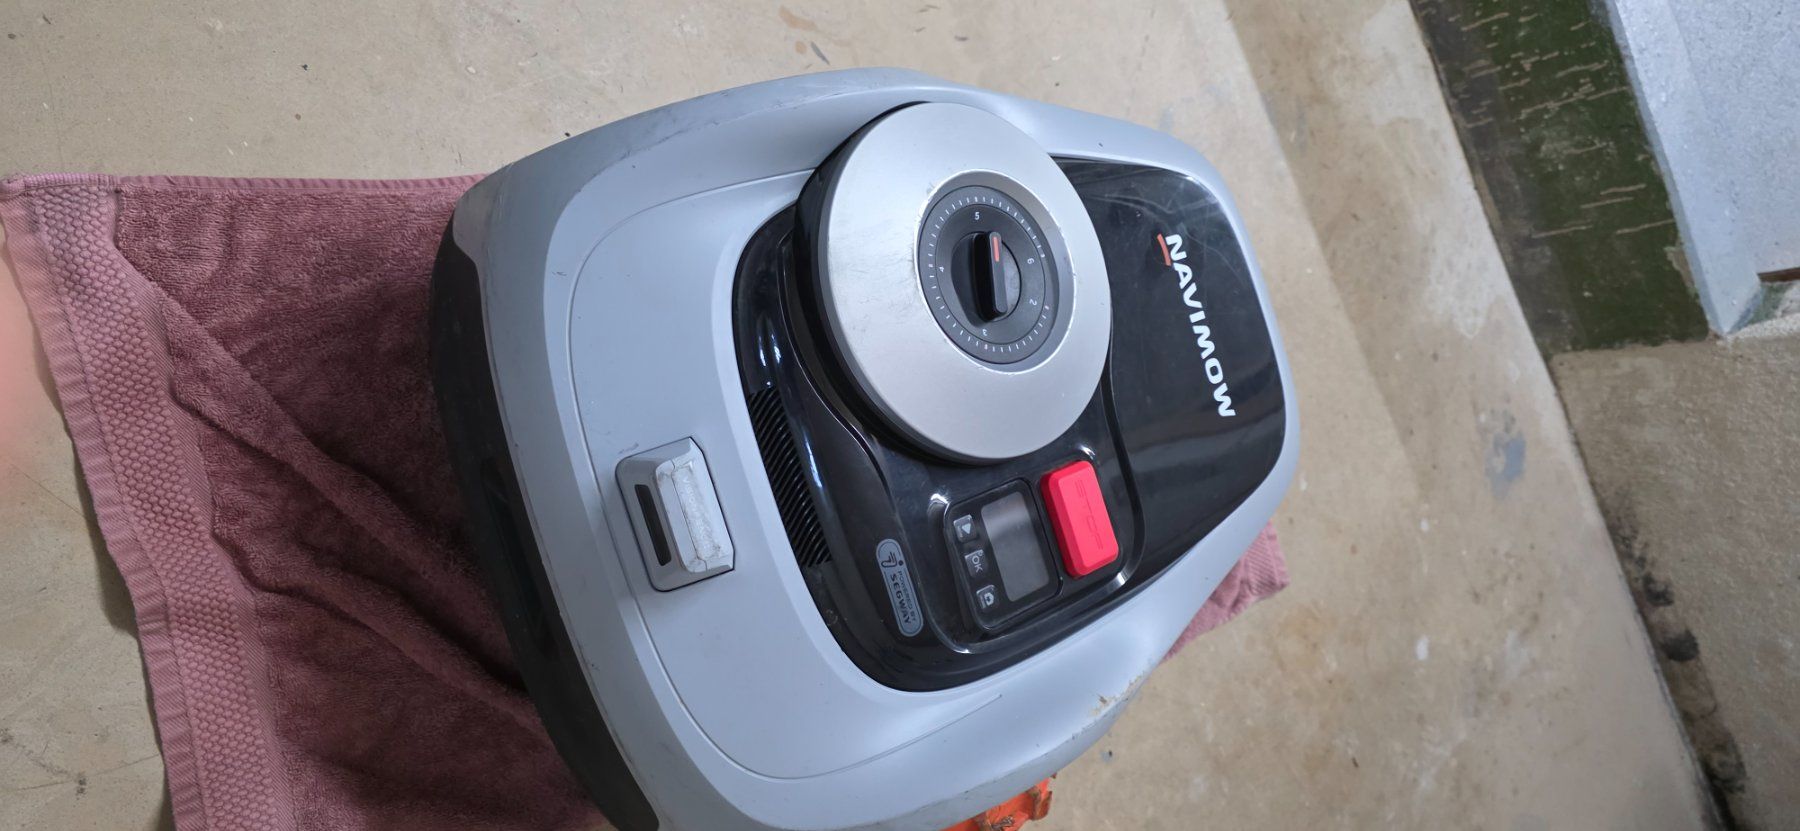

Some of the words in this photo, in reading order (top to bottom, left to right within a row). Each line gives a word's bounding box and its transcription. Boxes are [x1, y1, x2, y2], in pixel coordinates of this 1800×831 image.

[975, 211, 980, 220] 5
[1029, 298, 1037, 306] 2
[983, 328, 988, 336] 3
[1165, 233, 1236, 417] NAVIMOW
[1074, 479, 1104, 550] STOP
[972, 555, 983, 573] OK
[890, 573, 911, 624] SEGWAY
[898, 570, 913, 609] POWERED
